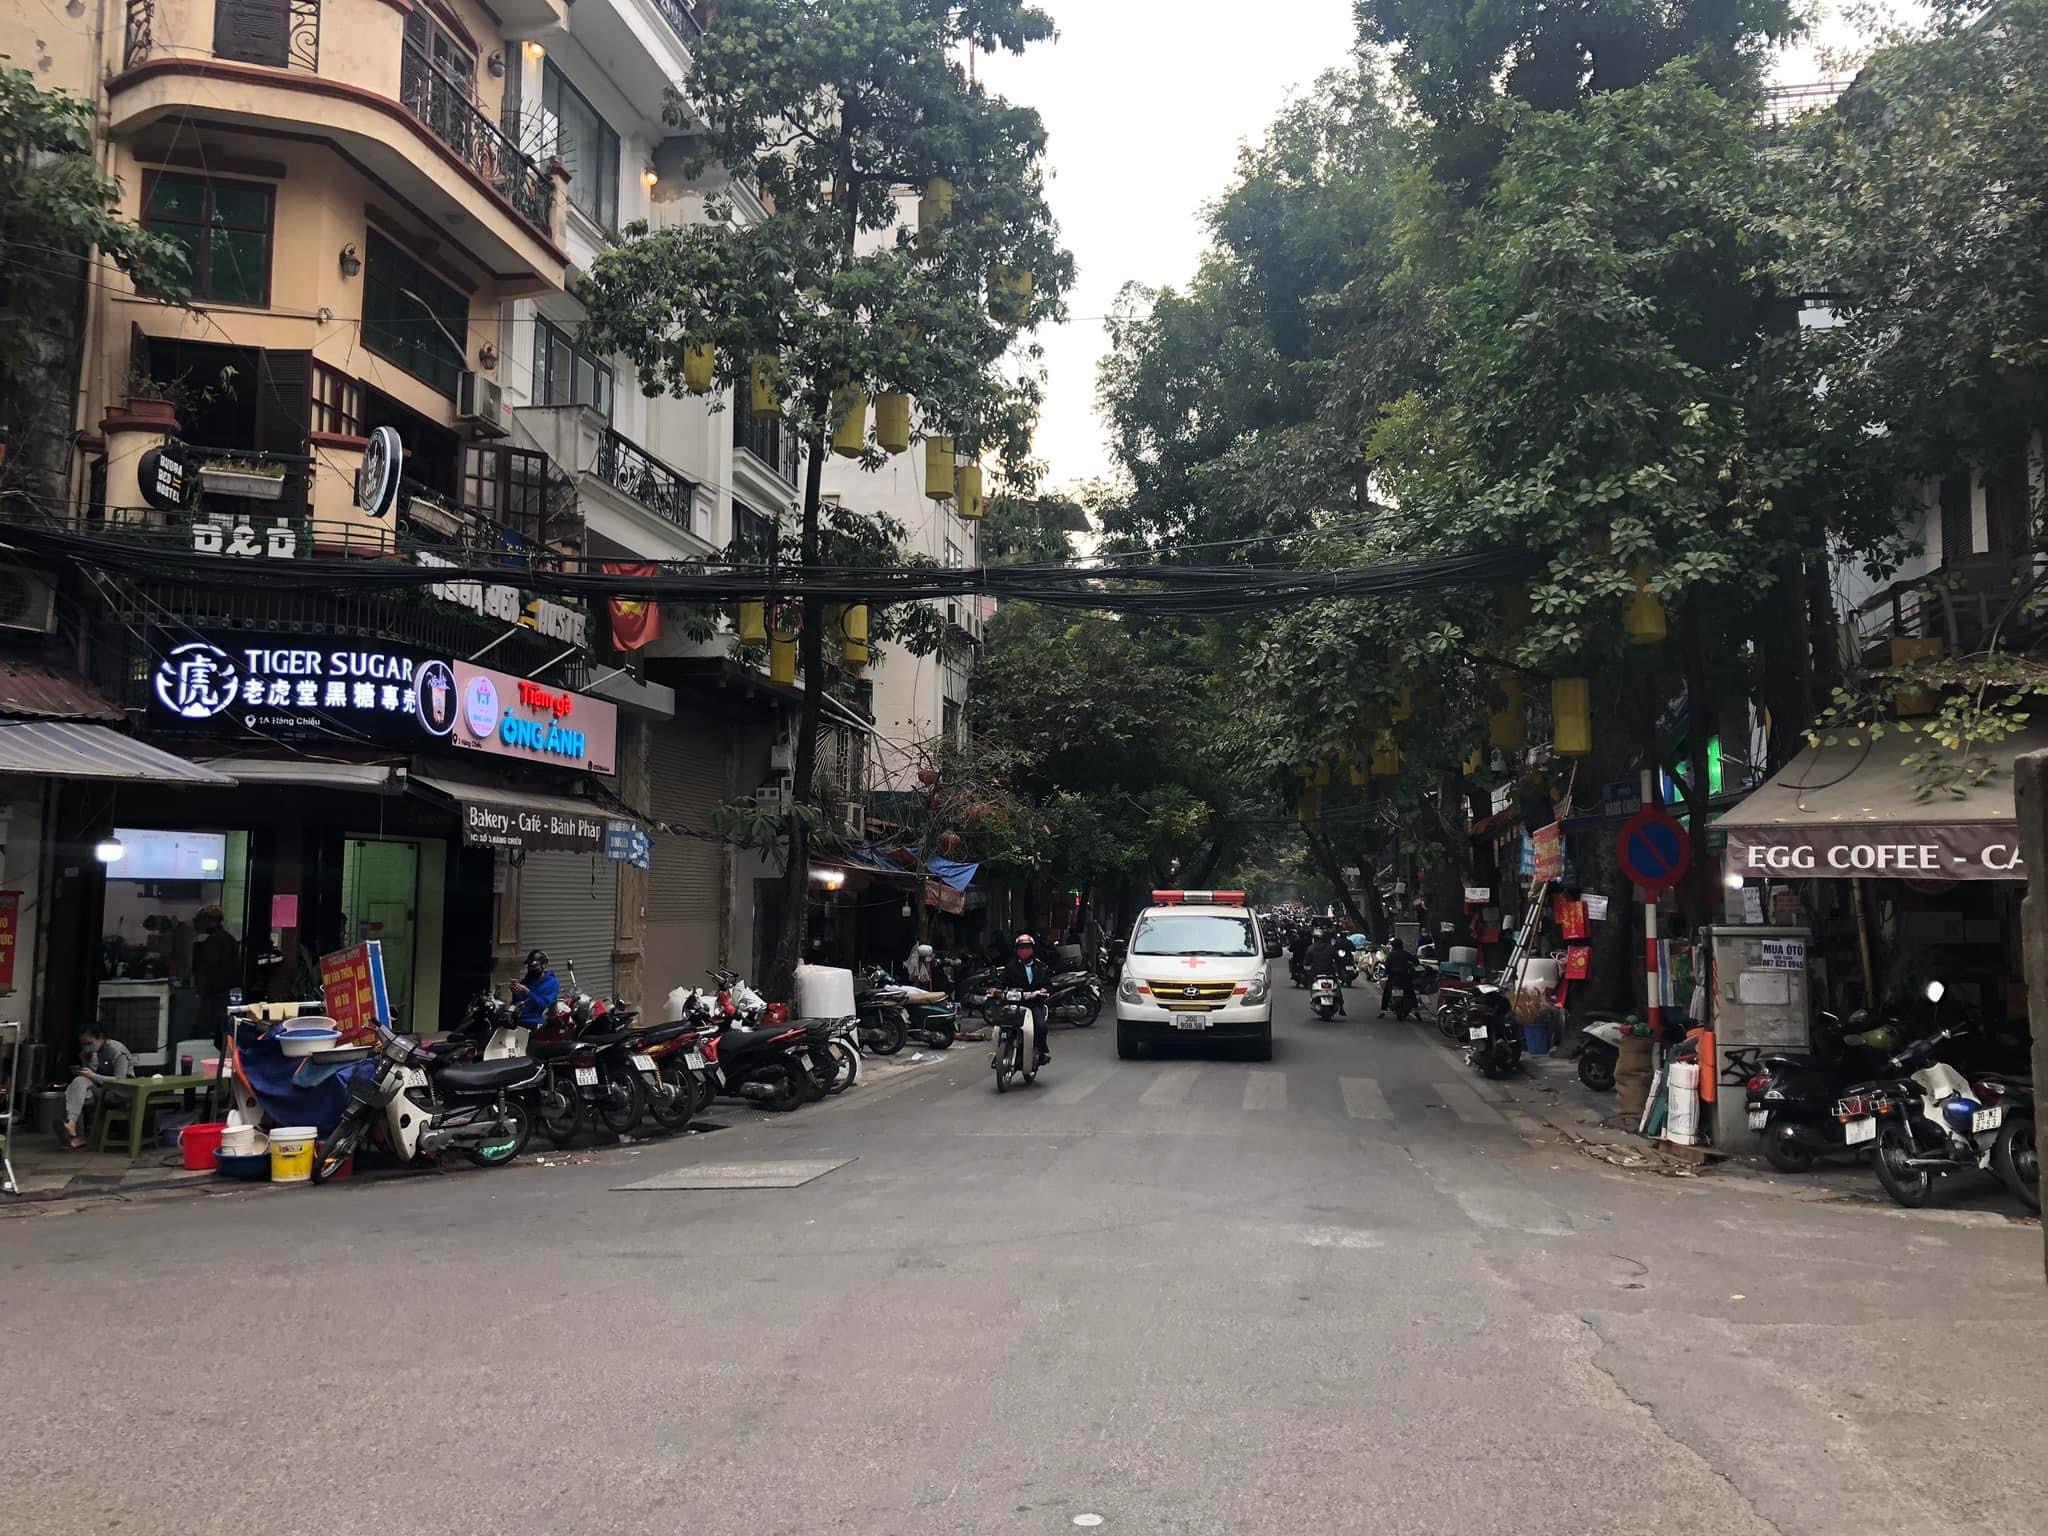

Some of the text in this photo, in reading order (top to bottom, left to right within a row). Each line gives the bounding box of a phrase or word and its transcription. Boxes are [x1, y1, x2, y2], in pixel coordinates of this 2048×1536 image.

[244, 649, 322, 675] TIGER
[329, 651, 413, 682] SUGAR
[470, 806, 509, 833] Bakery
[518, 812, 541, 833] Café
[550, 816, 575, 836] Bánh
[578, 819, 601, 842] Pháp
[1748, 846, 1816, 869] EGG
[1828, 845, 1942, 870] COFEE
[1763, 944, 1784, 955] MUA
